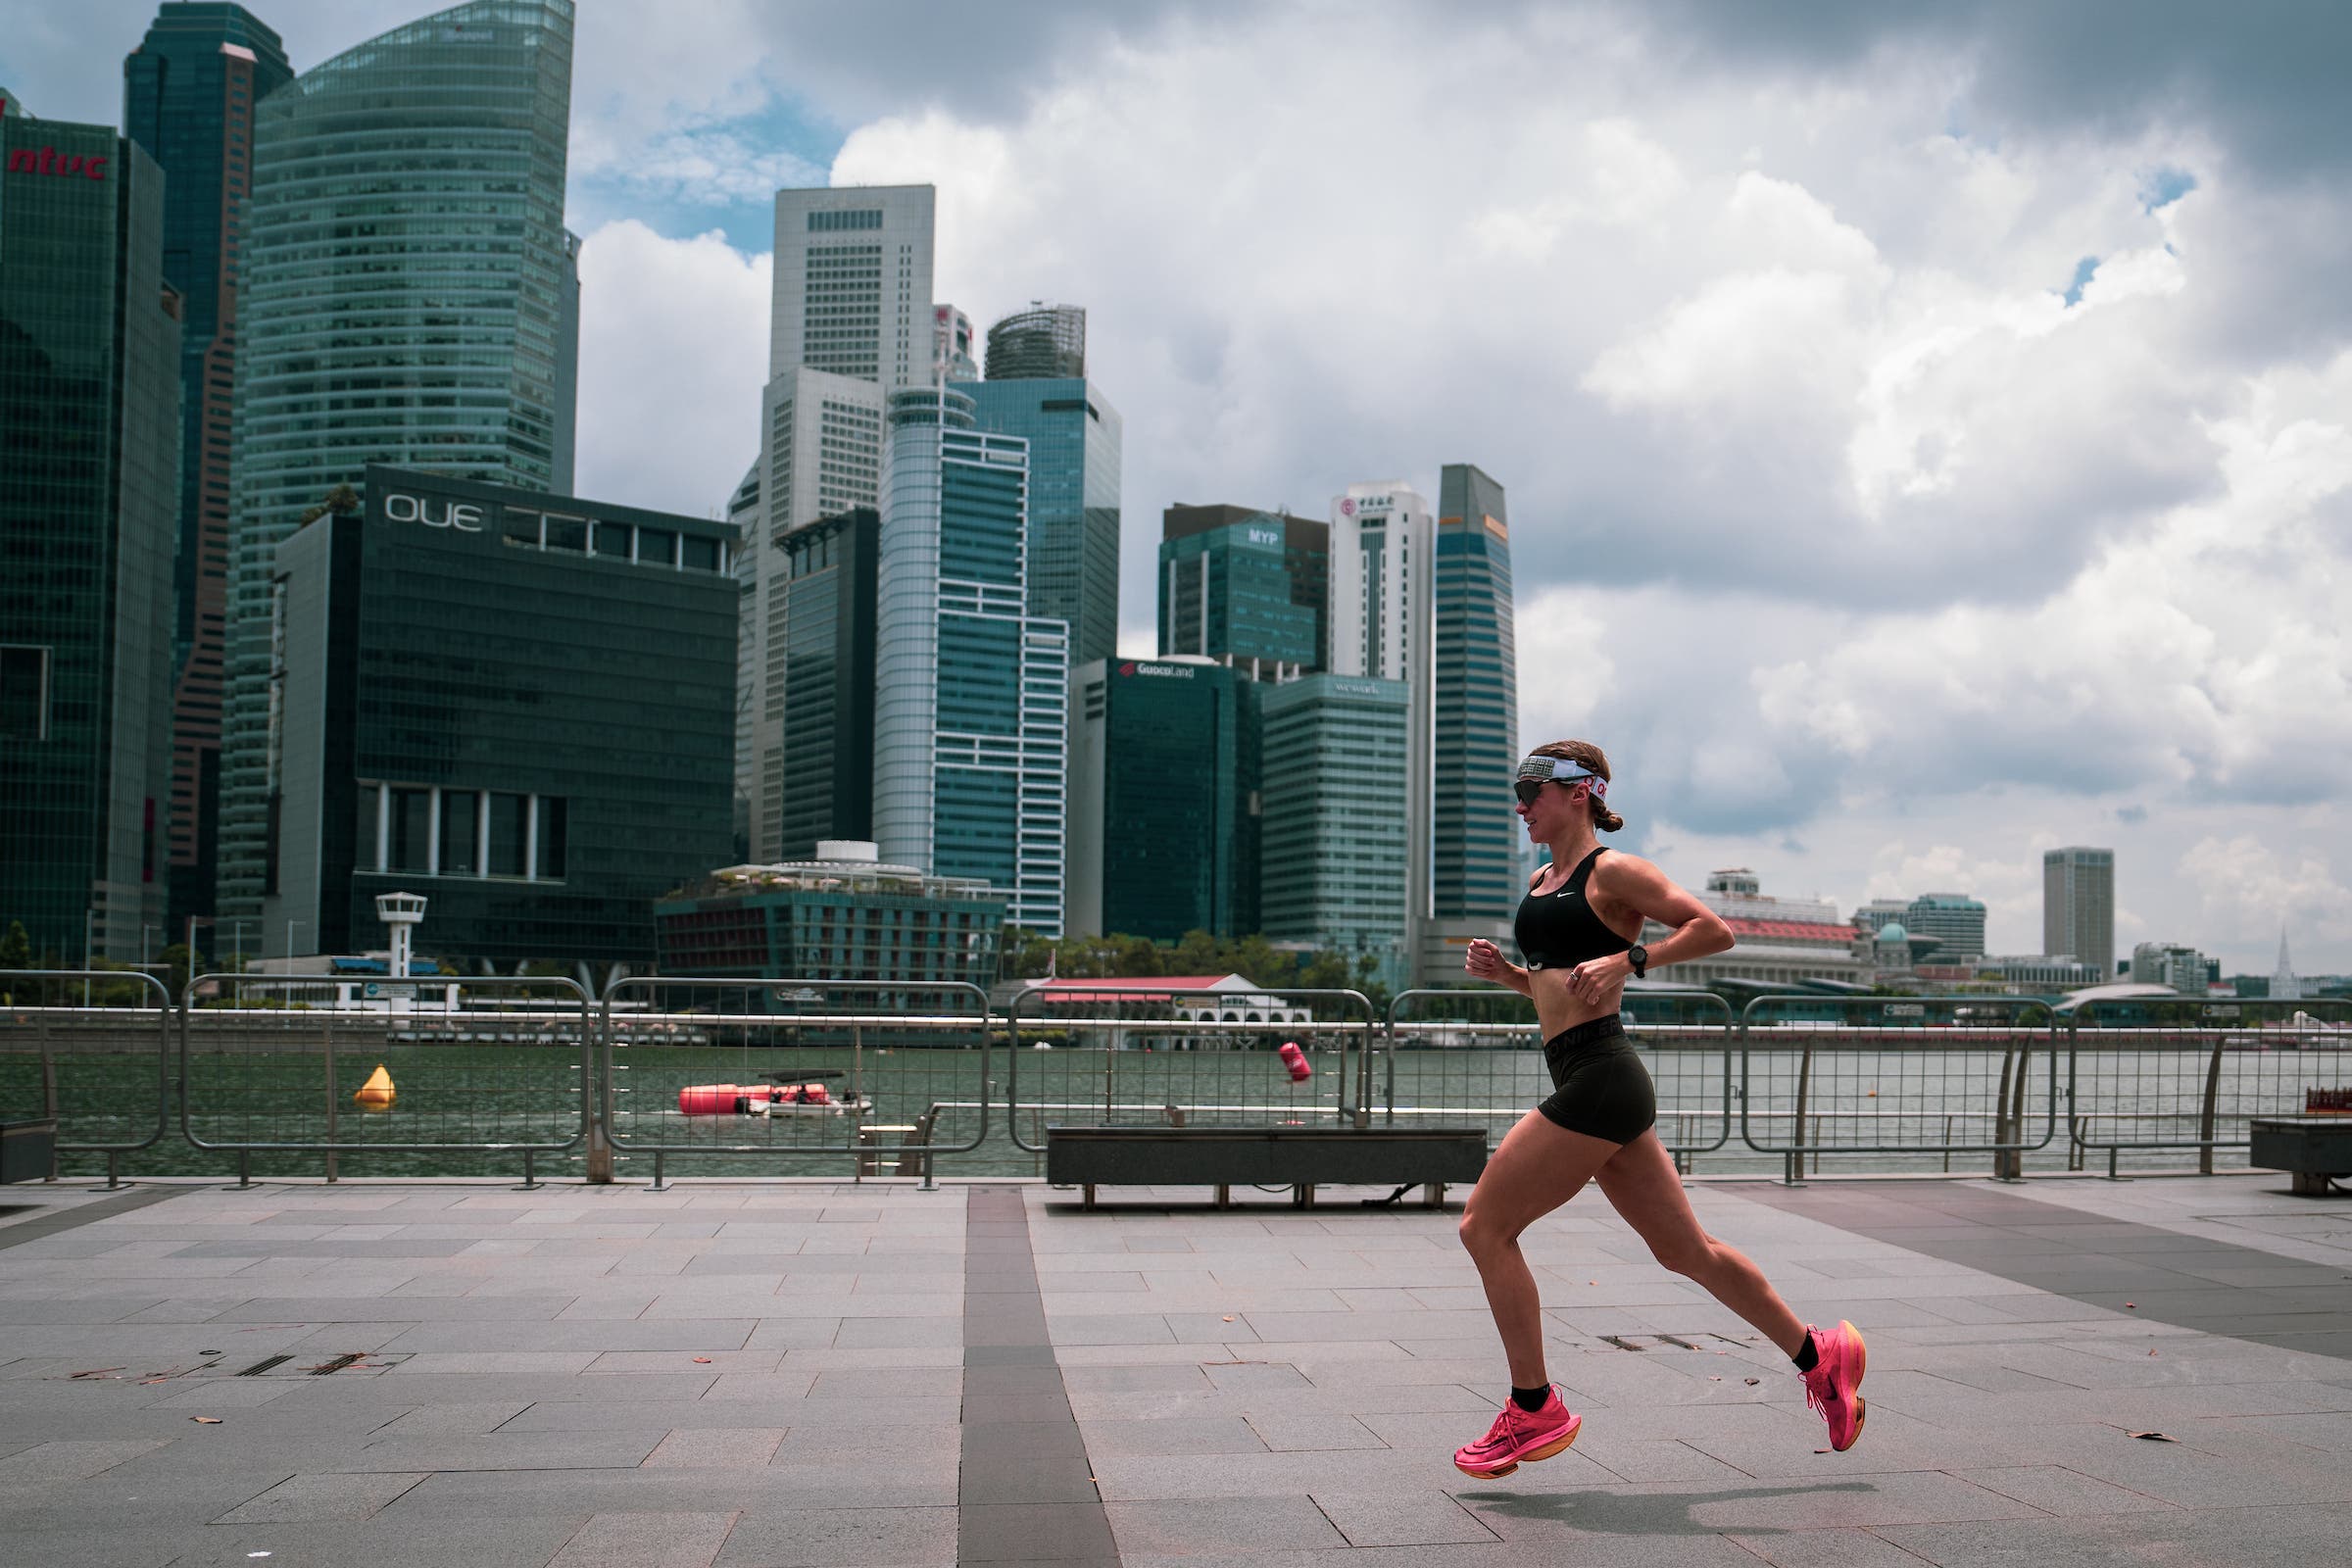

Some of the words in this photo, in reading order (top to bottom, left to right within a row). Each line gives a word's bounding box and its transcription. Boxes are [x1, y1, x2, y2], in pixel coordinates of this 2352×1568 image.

[8, 145, 108, 180] ntuc
[384, 494, 483, 532] OUE
[1249, 529, 1279, 546] MYP
